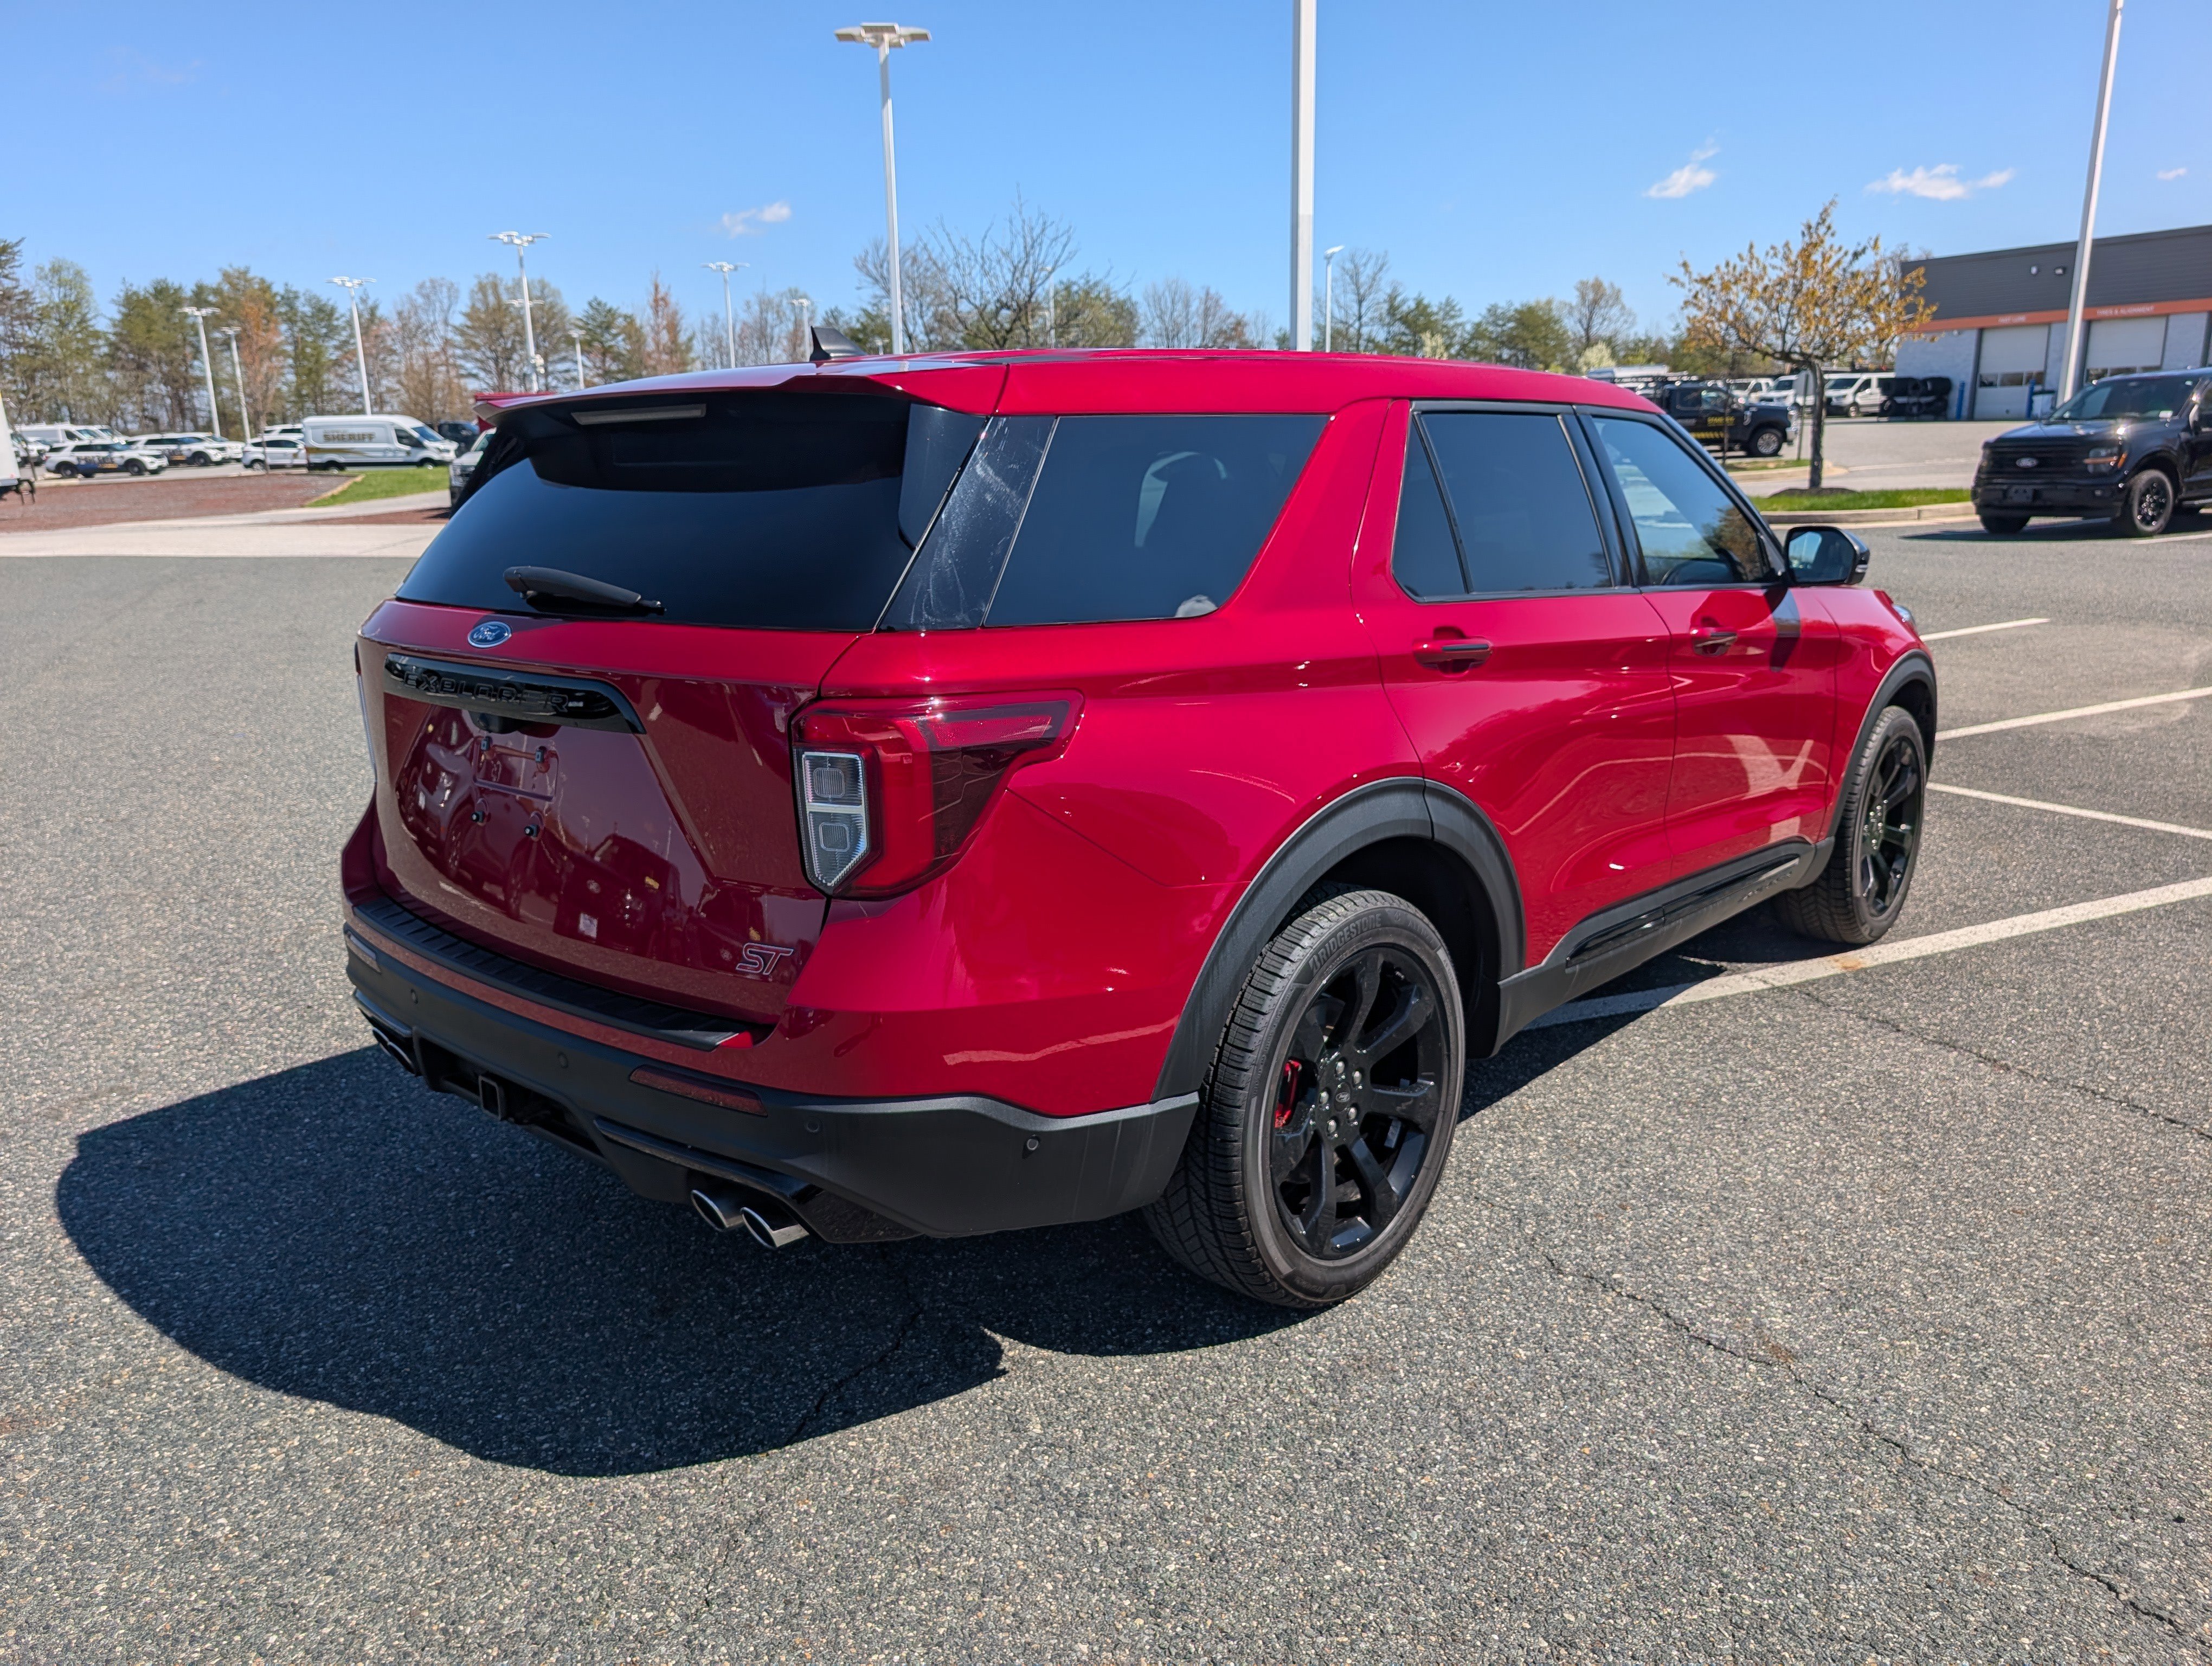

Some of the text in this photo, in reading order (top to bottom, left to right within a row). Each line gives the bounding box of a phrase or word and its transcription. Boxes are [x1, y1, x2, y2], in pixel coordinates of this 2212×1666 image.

[323, 433, 376, 443] SHERIFF
[472, 623, 503, 642] Ford
[404, 671, 569, 713] EXPLORER
[735, 942, 794, 976] ST
[1308, 913, 1383, 974] BRIDGESTONE
